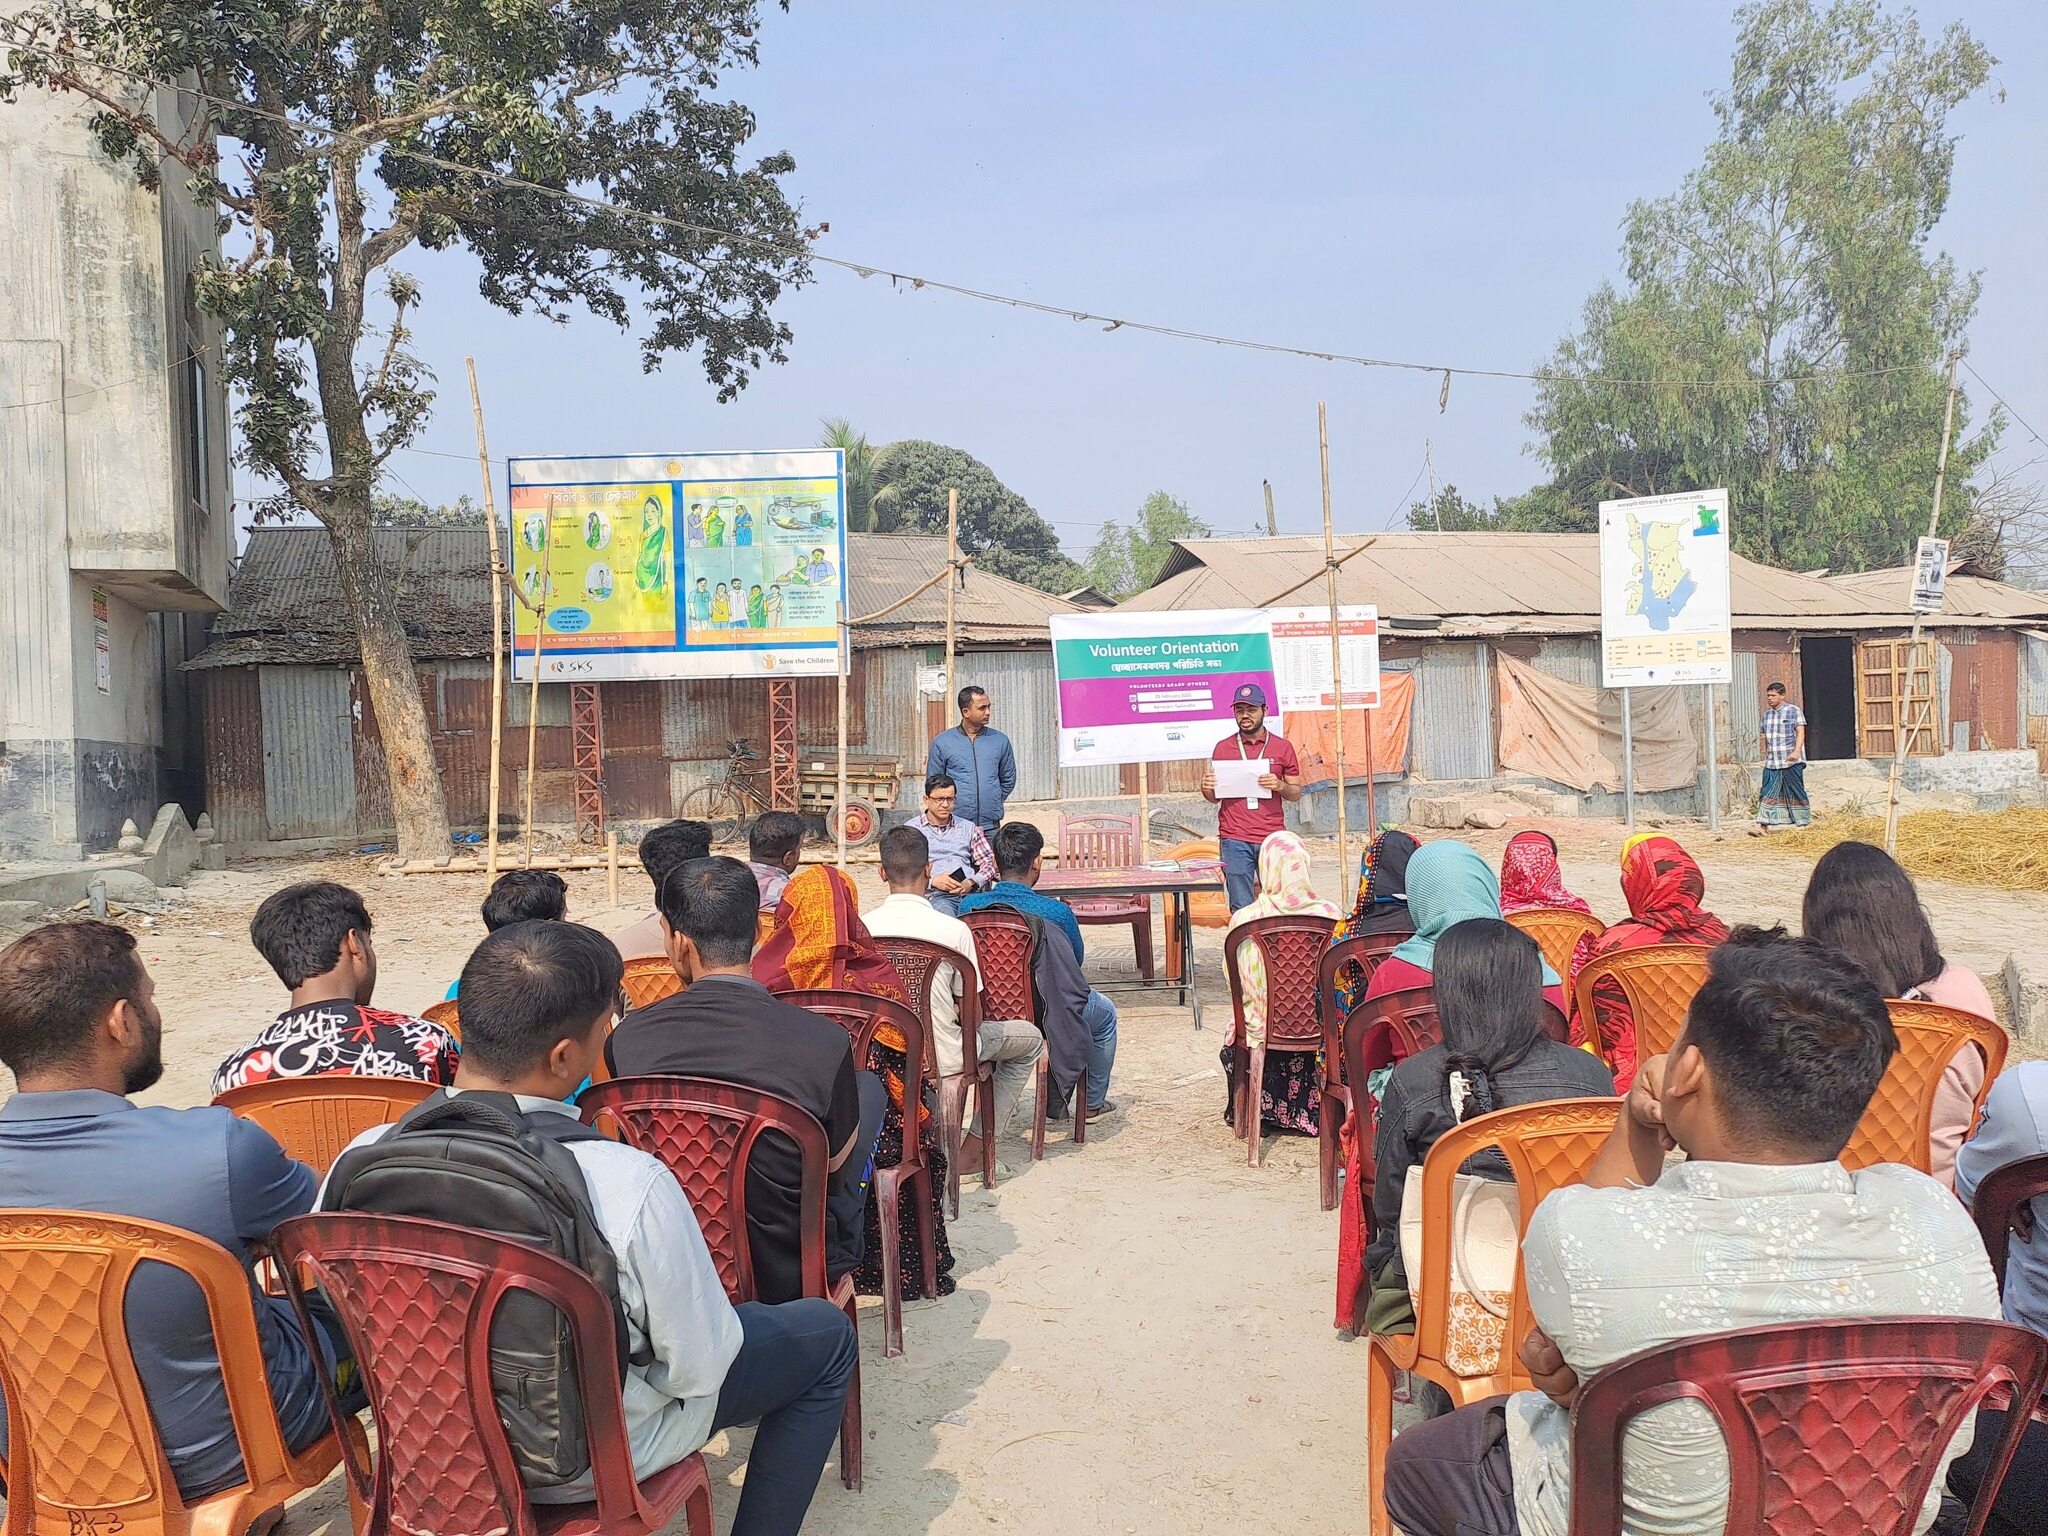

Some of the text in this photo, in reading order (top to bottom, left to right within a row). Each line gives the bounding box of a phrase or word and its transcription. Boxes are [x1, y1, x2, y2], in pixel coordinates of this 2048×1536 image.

[1088, 640, 1239, 657] Volunteer Orientation
[807, 656, 834, 664] Children
[1172, 658, 1204, 670] পরিচিতি
[1206, 659, 1222, 668] সভা
[568, 660, 593, 673] SKS
